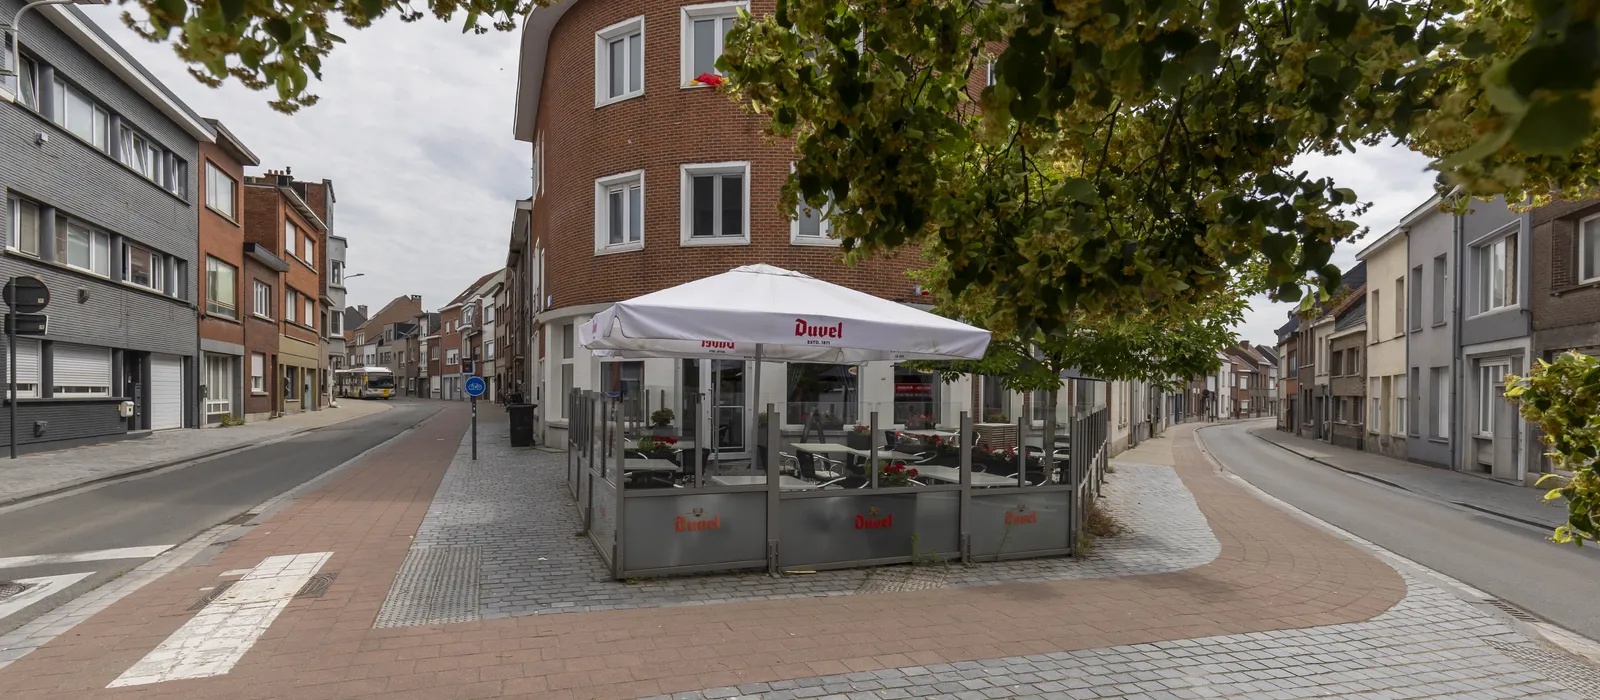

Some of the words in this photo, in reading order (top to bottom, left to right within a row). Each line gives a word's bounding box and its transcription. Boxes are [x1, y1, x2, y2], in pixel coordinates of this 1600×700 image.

[795, 318, 843, 339] Duvel
[674, 514, 721, 532] Duvel
[855, 513, 893, 529] Duvel
[1004, 510, 1038, 525] Duvel
